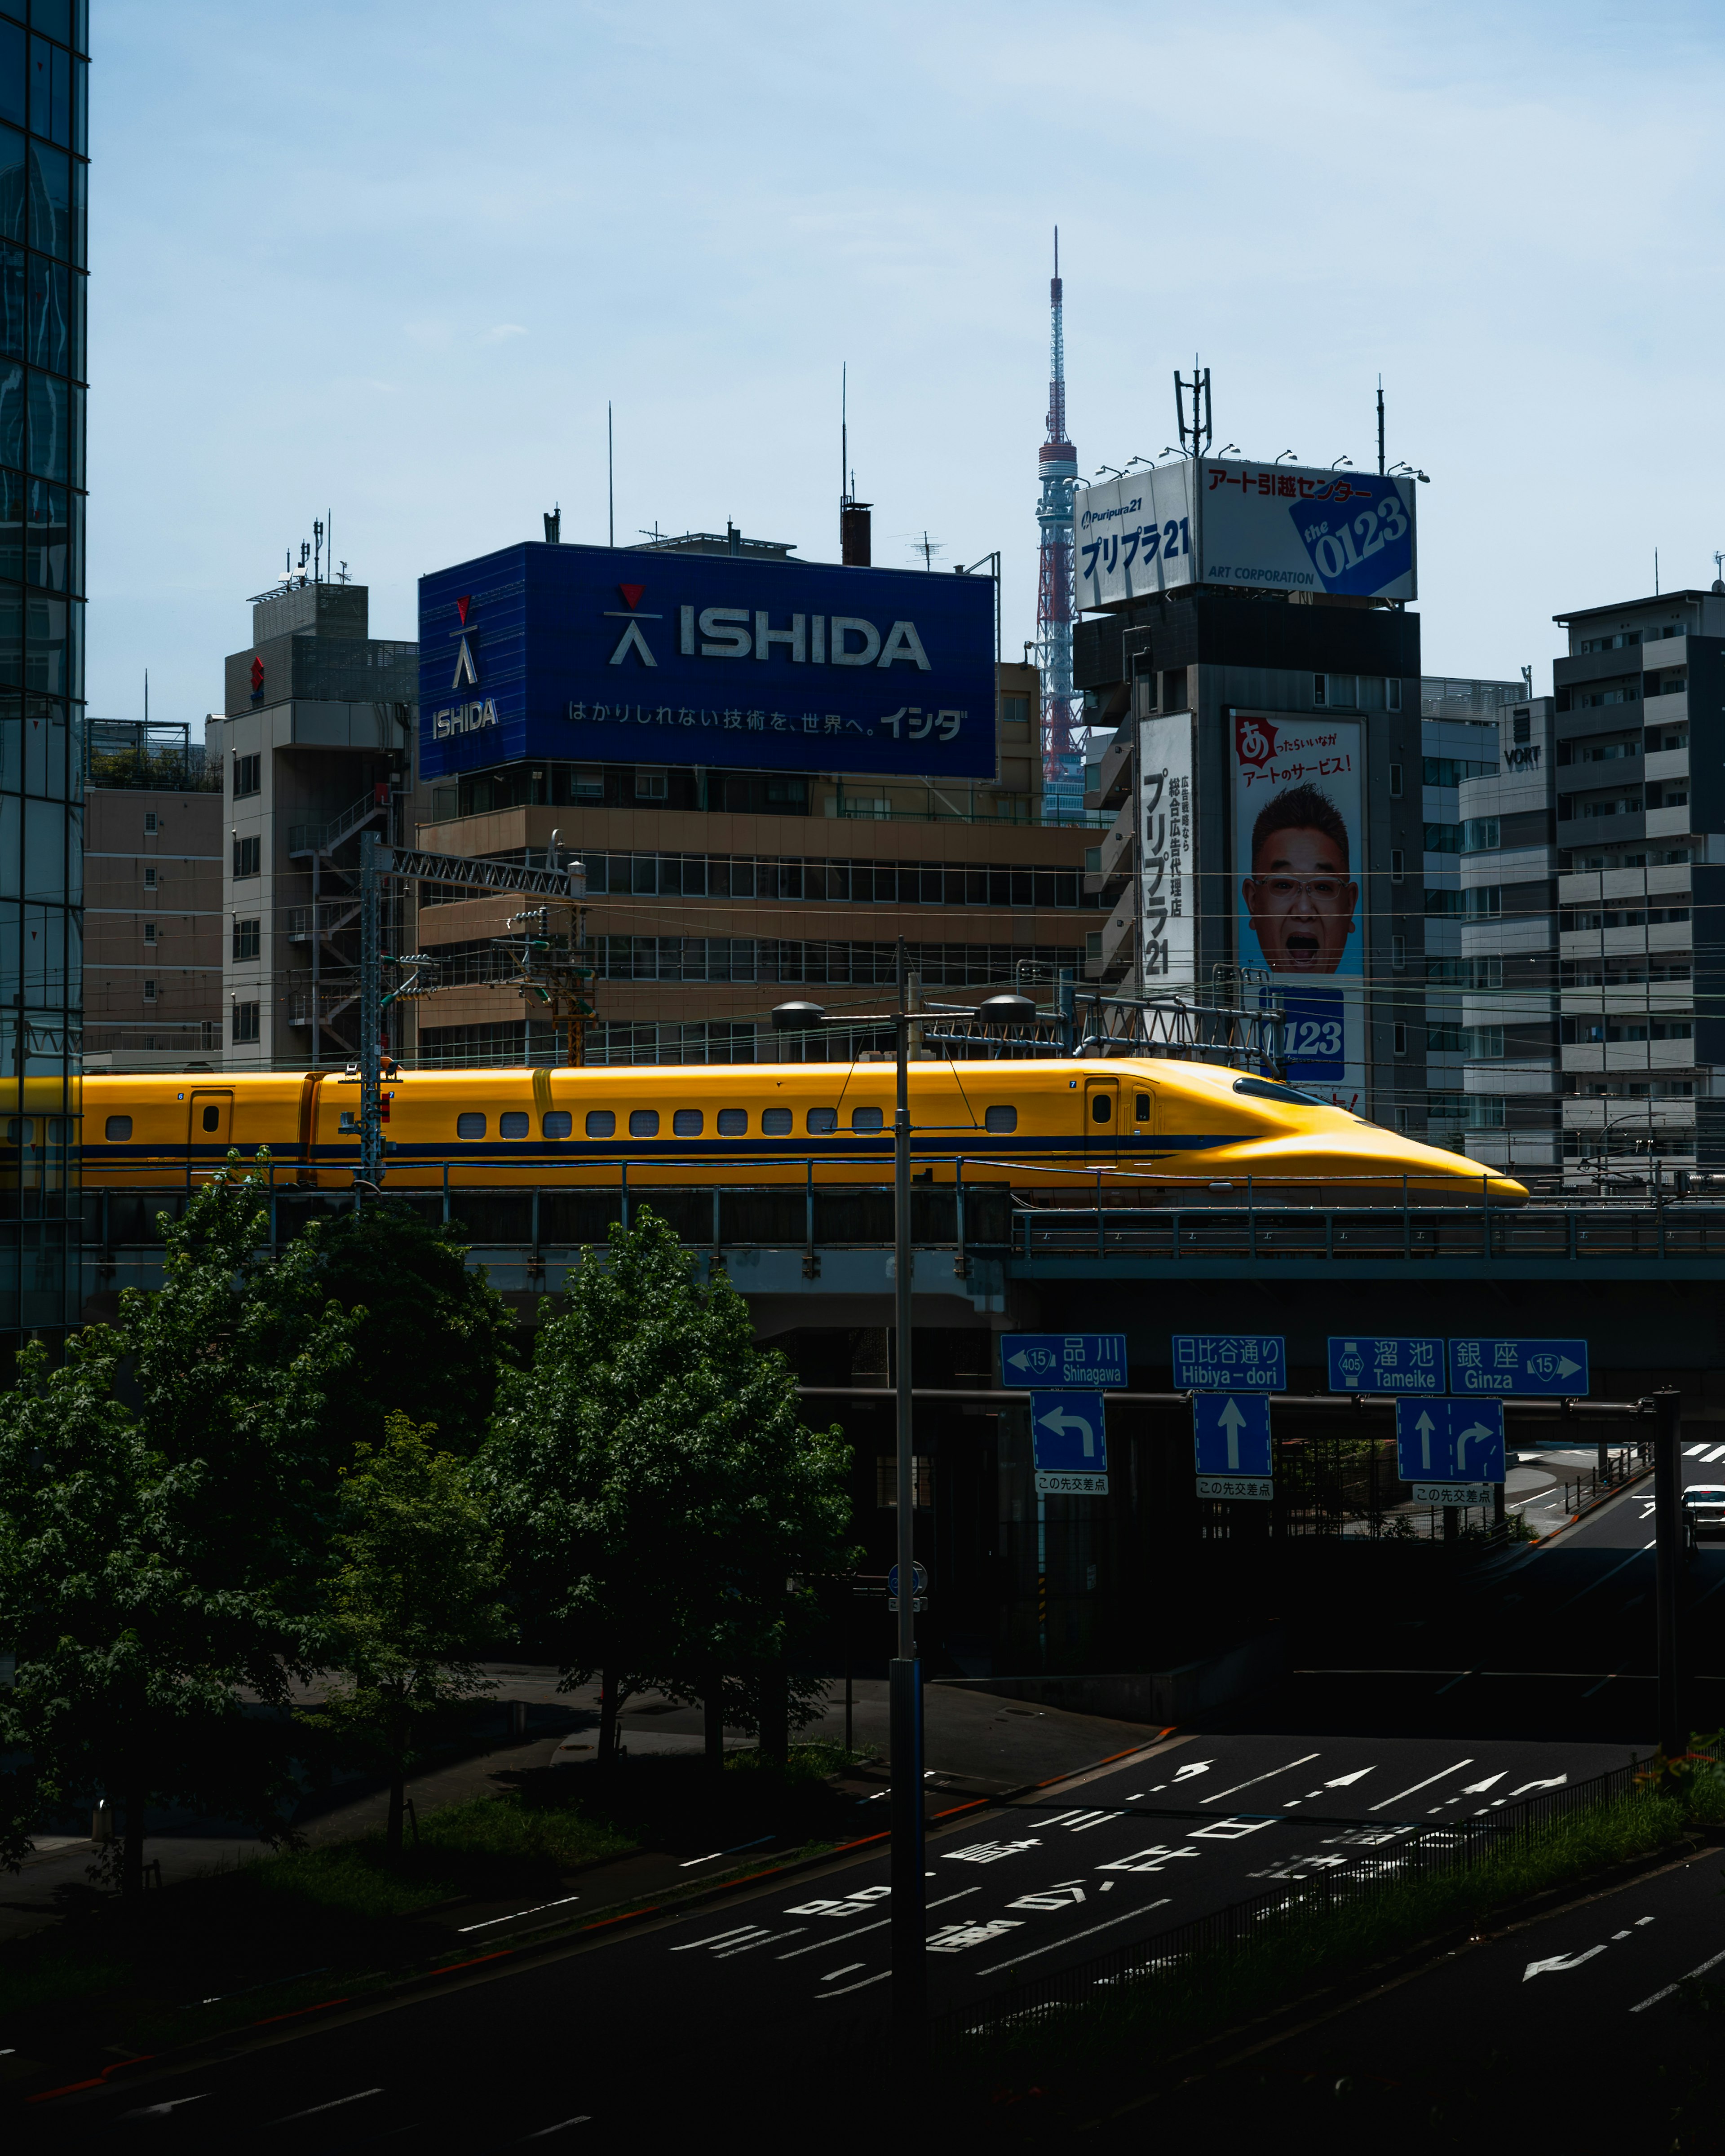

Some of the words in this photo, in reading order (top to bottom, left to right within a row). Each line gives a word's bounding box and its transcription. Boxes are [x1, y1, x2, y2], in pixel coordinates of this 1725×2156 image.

[1208, 469, 1371, 502] アート引越センター
[1092, 497, 1142, 523] Puripura21
[1305, 521, 1329, 544] the
[1315, 496, 1407, 578] 0123
[1082, 517, 1189, 579] プリプラ21
[1208, 566, 1230, 579] ART
[1234, 568, 1314, 585] CORPORATION
[681, 605, 932, 670] ISHIDA
[433, 698, 499, 739] ISHIDA
[881, 707, 968, 740] イシダ
[1504, 746, 1540, 765] VORT
[1169, 777, 1181, 917] 総合広告代理店
[1144, 768, 1168, 975] プリプラ21
[1031, 1351, 1046, 1365] 15
[1064, 1338, 1118, 1362] 品川
[1178, 1339, 1279, 1364] 日比谷通り
[1063, 1365, 1121, 1384] Shinagawa
[1342, 1359, 1361, 1371] 405
[1536, 1357, 1552, 1373] 15
[1373, 1369, 1435, 1387] Tameike
[1465, 1370, 1513, 1389] Ginza
[1039, 1477, 1105, 1491] この先交差点
[1200, 1481, 1270, 1497] この先交差点
[1417, 1488, 1491, 1503] この先交差点
